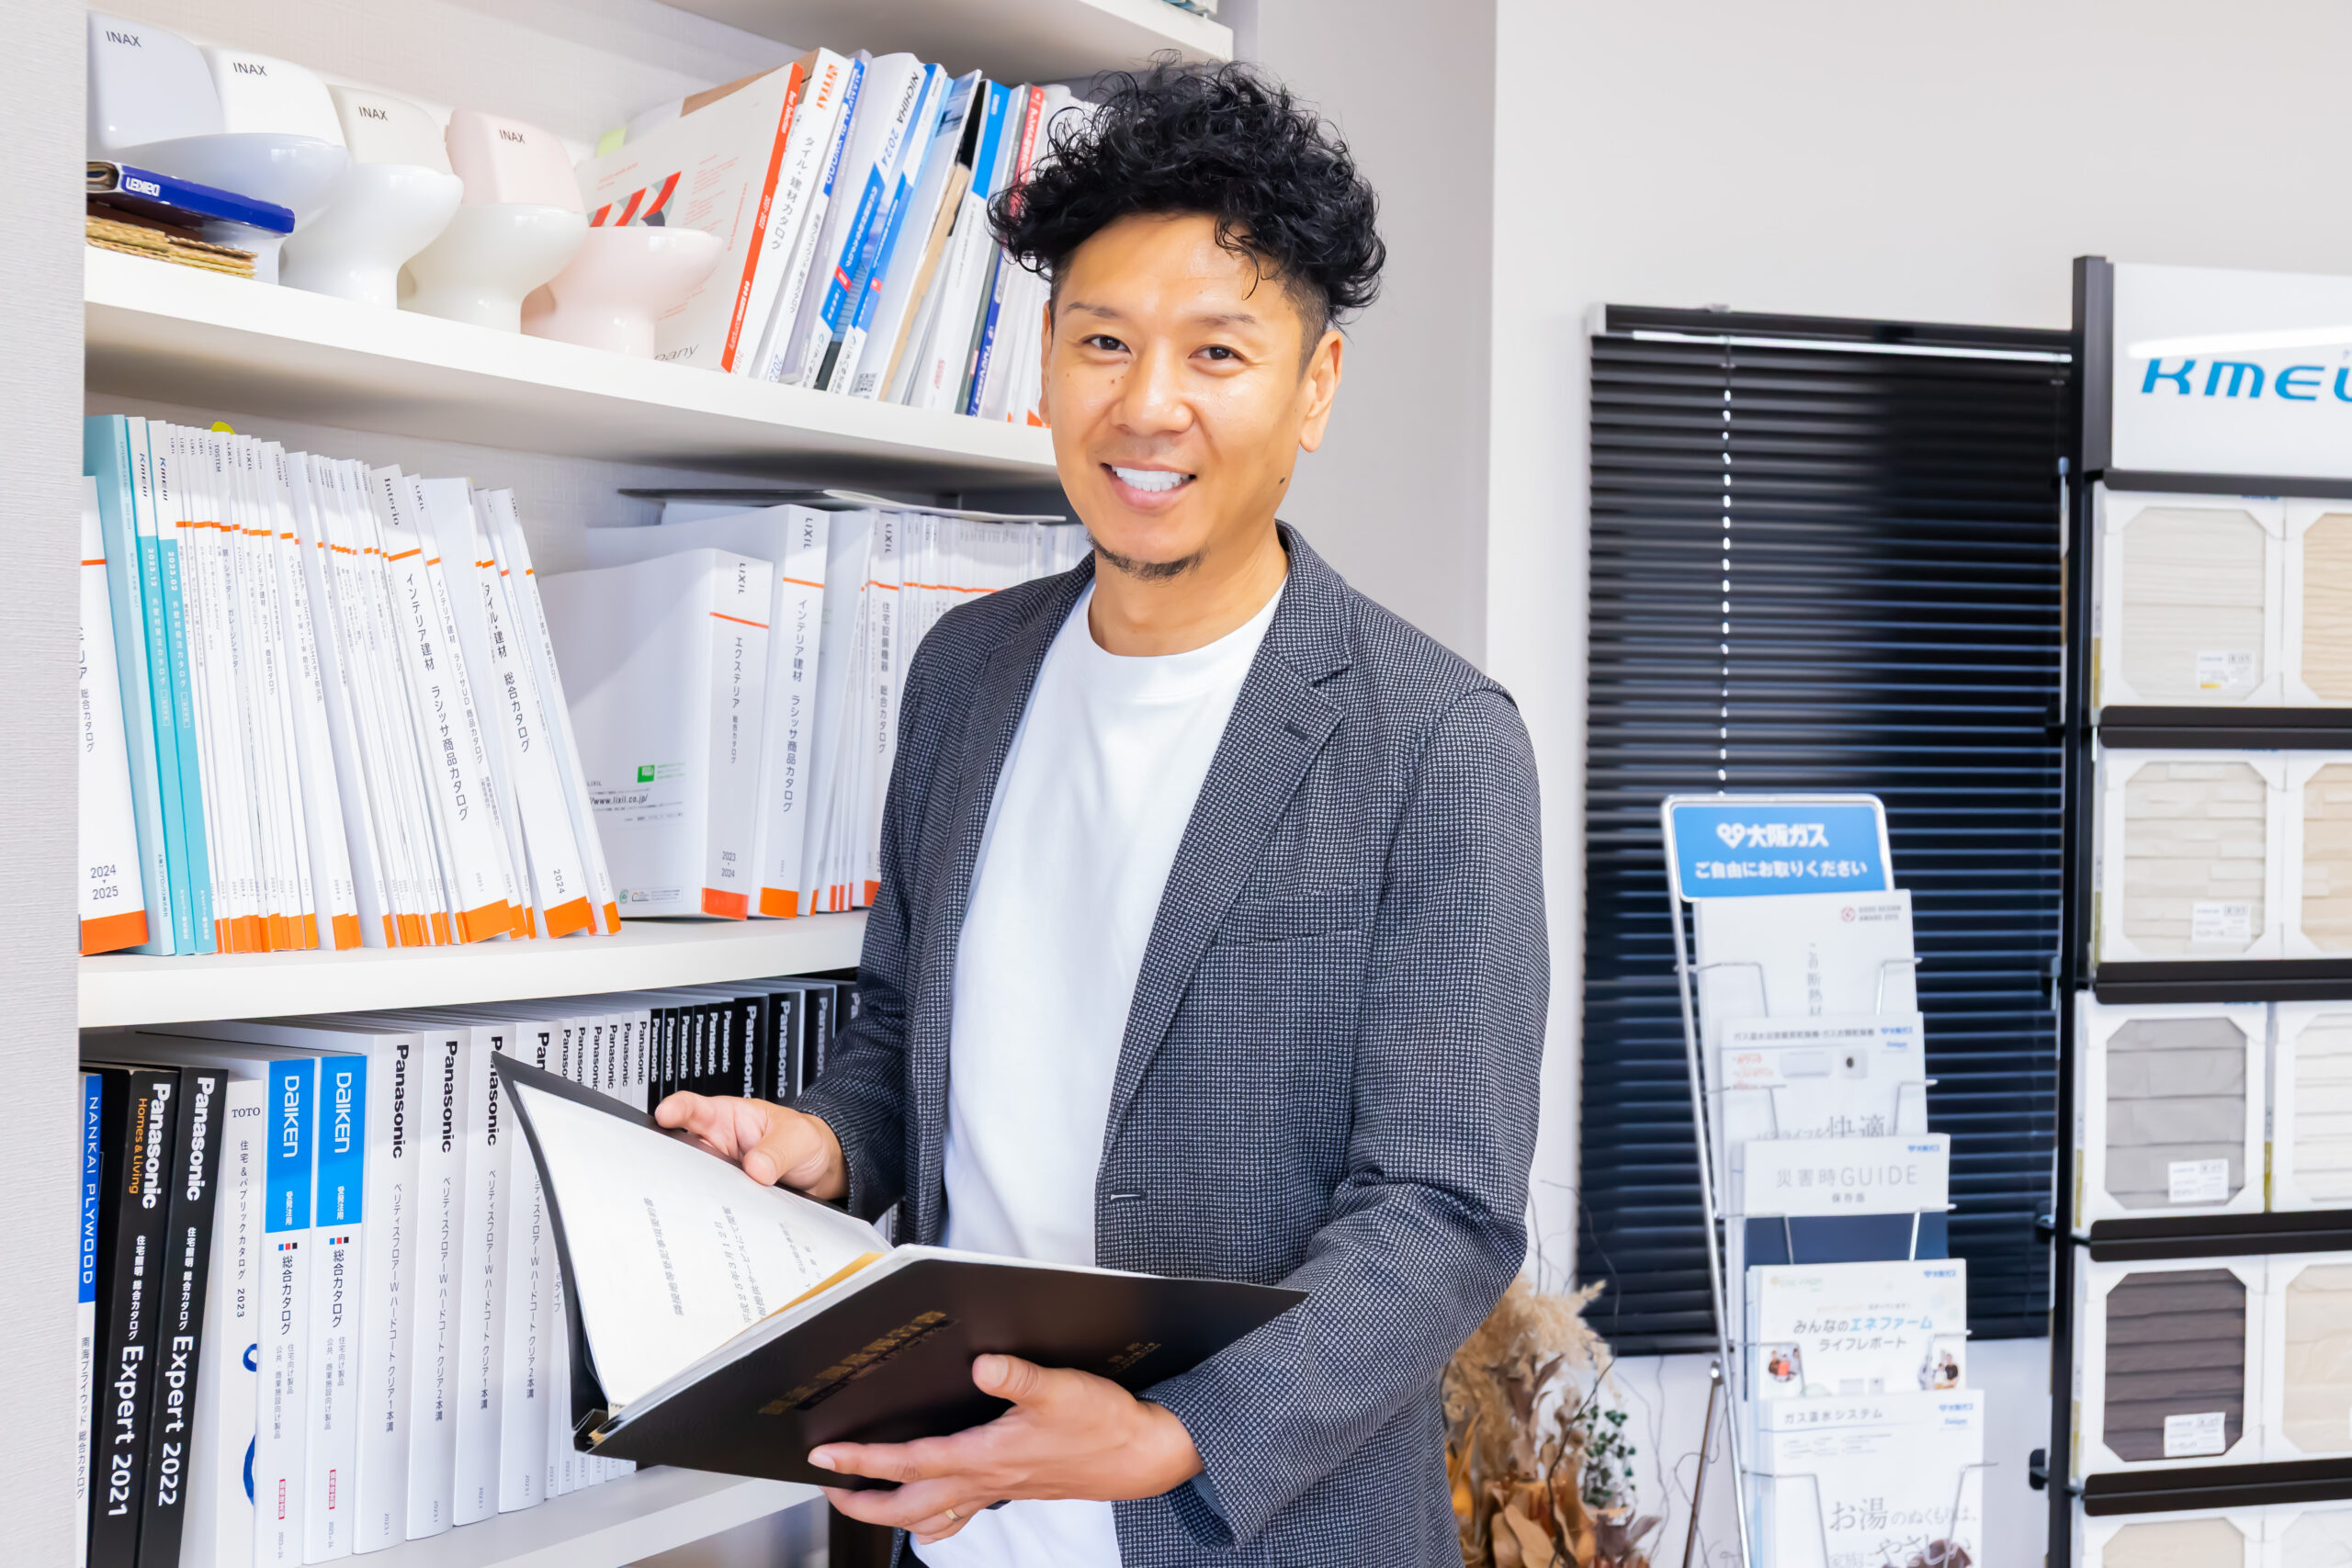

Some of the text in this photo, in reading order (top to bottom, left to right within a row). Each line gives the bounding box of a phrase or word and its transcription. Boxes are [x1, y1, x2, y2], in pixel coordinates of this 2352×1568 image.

[107, 30, 141, 48] INAX
[232, 62, 267, 77] INAX
[358, 106, 388, 121] INAX
[896, 71, 919, 124] NICHIHA
[499, 129, 525, 144] INAX
[881, 127, 900, 168] 2024
[384, 478, 400, 525] Interio
[415, 485, 424, 512] LIXIL
[803, 517, 813, 549] LIXIL
[884, 524, 892, 554] LIXIL
[738, 562, 746, 594] LIXIL
[406, 572, 469, 822] インテリア建材 ラシッサ商品カタログ
[483, 584, 508, 659] タイル・建材
[503, 671, 530, 753] 総合カタログ
[730, 637, 743, 709] エクステリア
[783, 599, 808, 813] インテリア建材 ラシッサ商品カタログ
[721, 851, 737, 862] 2023
[1747, 823, 1829, 848] 大阪ガス
[90, 863, 117, 879] 2024
[92, 886, 119, 900] 2025
[553, 868, 566, 895] 2024
[720, 867, 736, 878] 2024
[1695, 861, 1868, 878] ご自由にお取りください
[607, 1024, 617, 1089] Panasonic
[622, 1022, 632, 1088] Panasonic
[637, 1021, 648, 1085] Panasonic
[650, 1018, 661, 1083] Panasonic
[665, 1017, 675, 1082] Panasonic
[680, 1015, 690, 1079] Panasonic
[694, 1014, 705, 1078] Panasonic
[707, 1012, 718, 1076] Panasonic
[722, 1010, 732, 1073] Panasonic
[777, 1000, 791, 1099] Panasonic
[135, 1098, 148, 1144] Homes
[232, 1107, 261, 1118] TOTO
[392, 1044, 409, 1159] Panasonic
[442, 1041, 458, 1153] Panasonic
[142, 1083, 172, 1210] Panasonic
[187, 1077, 215, 1201] Panasonic
[83, 1097, 98, 1284] NANKAI PLYWOOD
[129, 1153, 142, 1194] Living
[129, 1280, 142, 1340] 総合カタログ
[179, 1270, 192, 1330] 総合カタログ
[237, 1289, 245, 1318] 2023
[281, 1255, 293, 1335] 総合カタログ
[332, 1249, 345, 1328] 総合カタログ
[483, 1280, 492, 1340] ハードコート
[530, 1270, 538, 1333] ハードコート
[390, 1297, 398, 1362] ハードコート
[437, 1289, 447, 1352] ハードコート
[1793, 1316, 1933, 1334] みんなのエネファーム
[1818, 1337, 1907, 1352] ライフレポート
[108, 1346, 144, 1516] Expert 2021
[158, 1336, 194, 1507] Expert 2022
[76, 1431, 88, 1500] 総合カタログ
